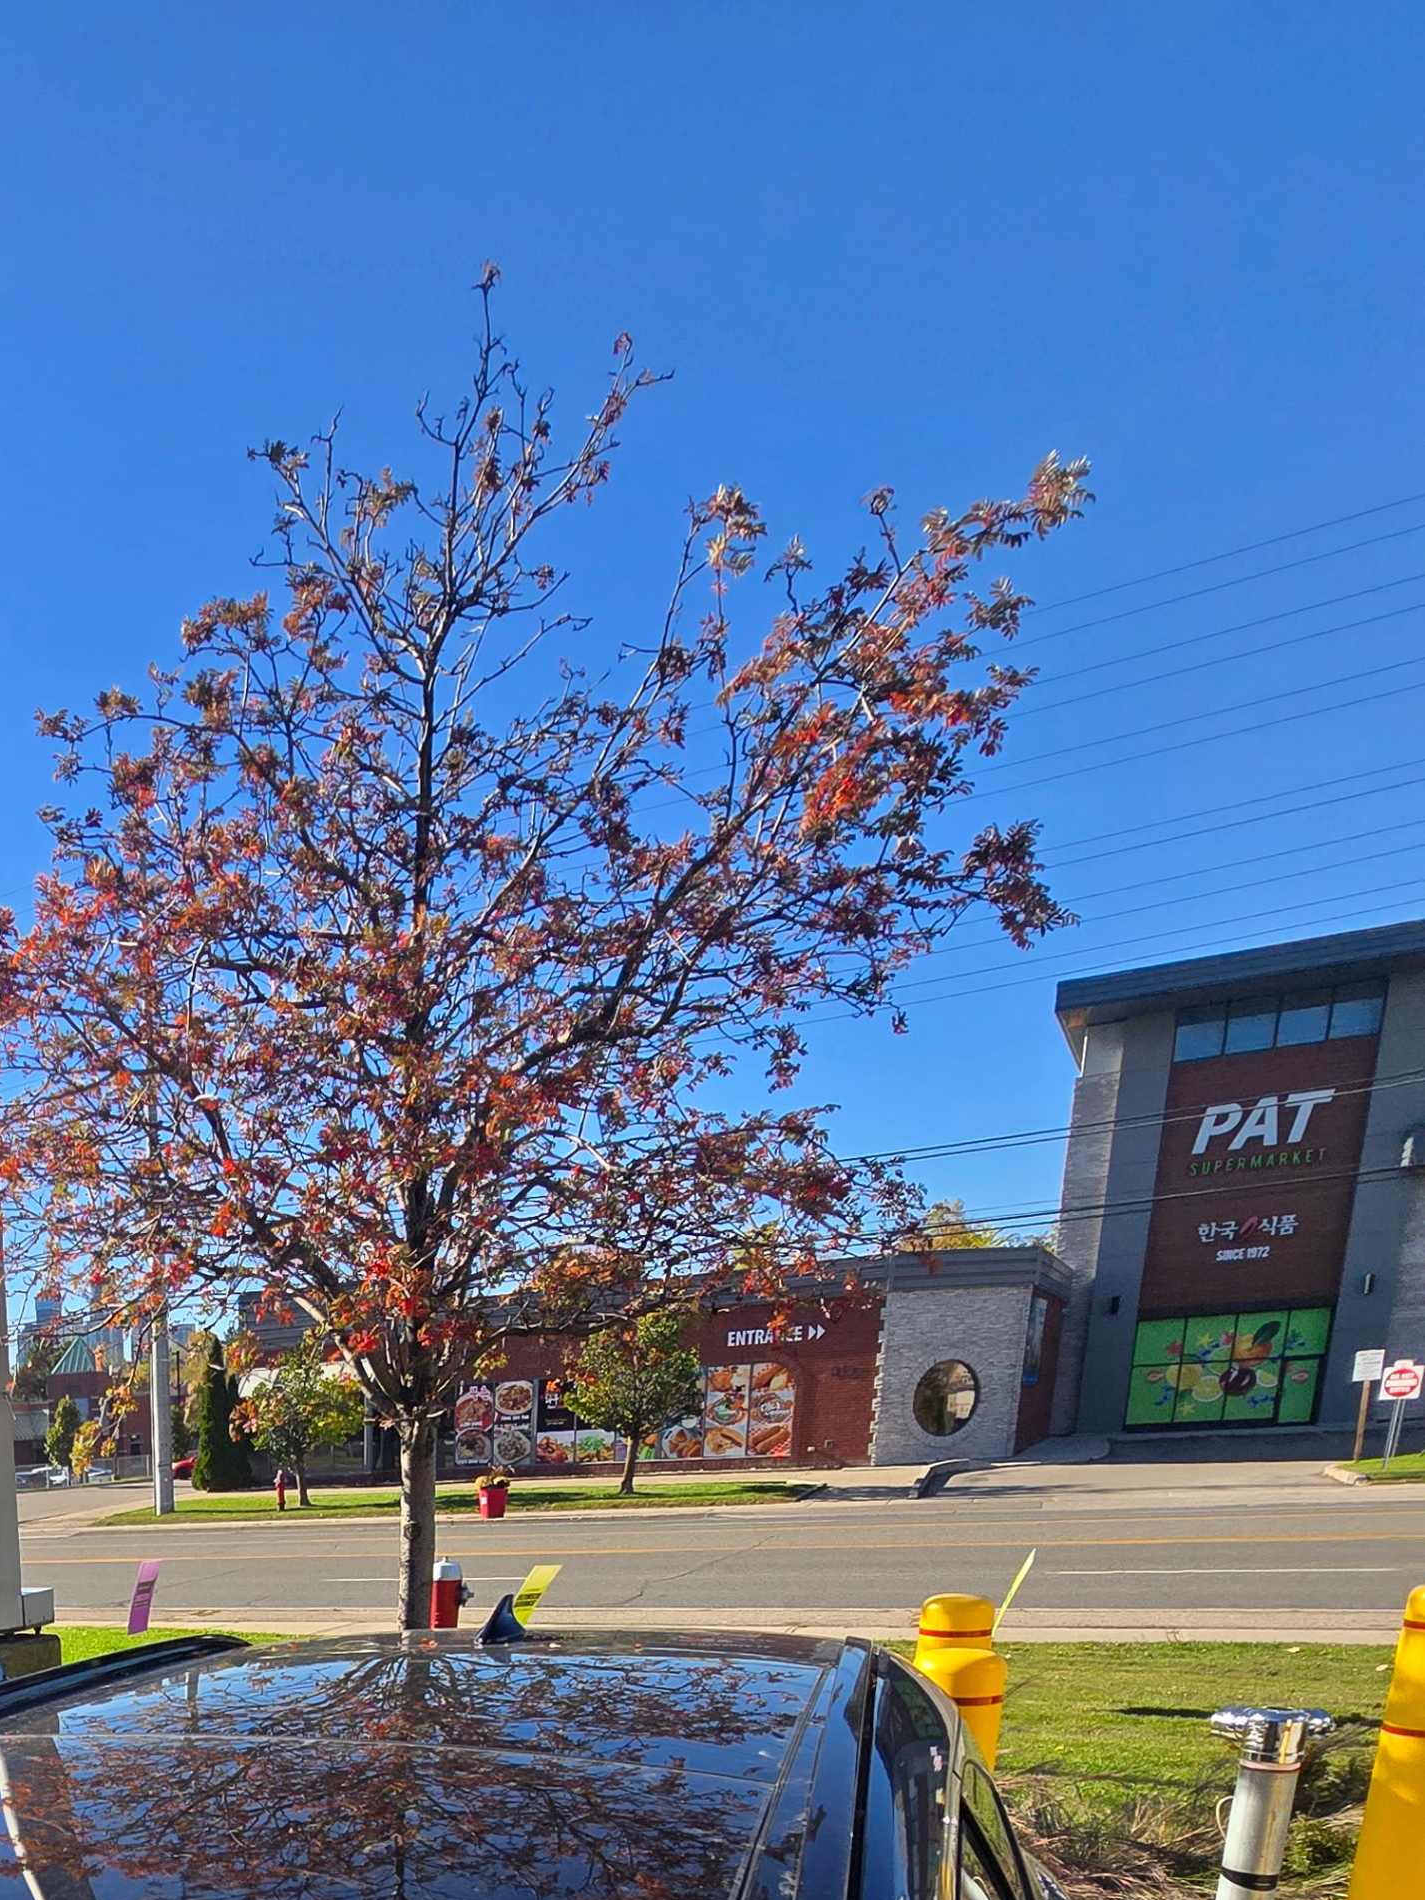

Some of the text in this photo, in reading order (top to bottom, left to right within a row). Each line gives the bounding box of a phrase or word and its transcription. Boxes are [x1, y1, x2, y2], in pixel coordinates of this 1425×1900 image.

[1191, 1088, 1335, 1155] PAT
[1190, 1148, 1327, 1177] SUPERMARKET
[1198, 1220, 1239, 1243] 한국
[1216, 1246, 1270, 1261] SINCE 1972
[727, 1326, 803, 1347] ENTRAE
